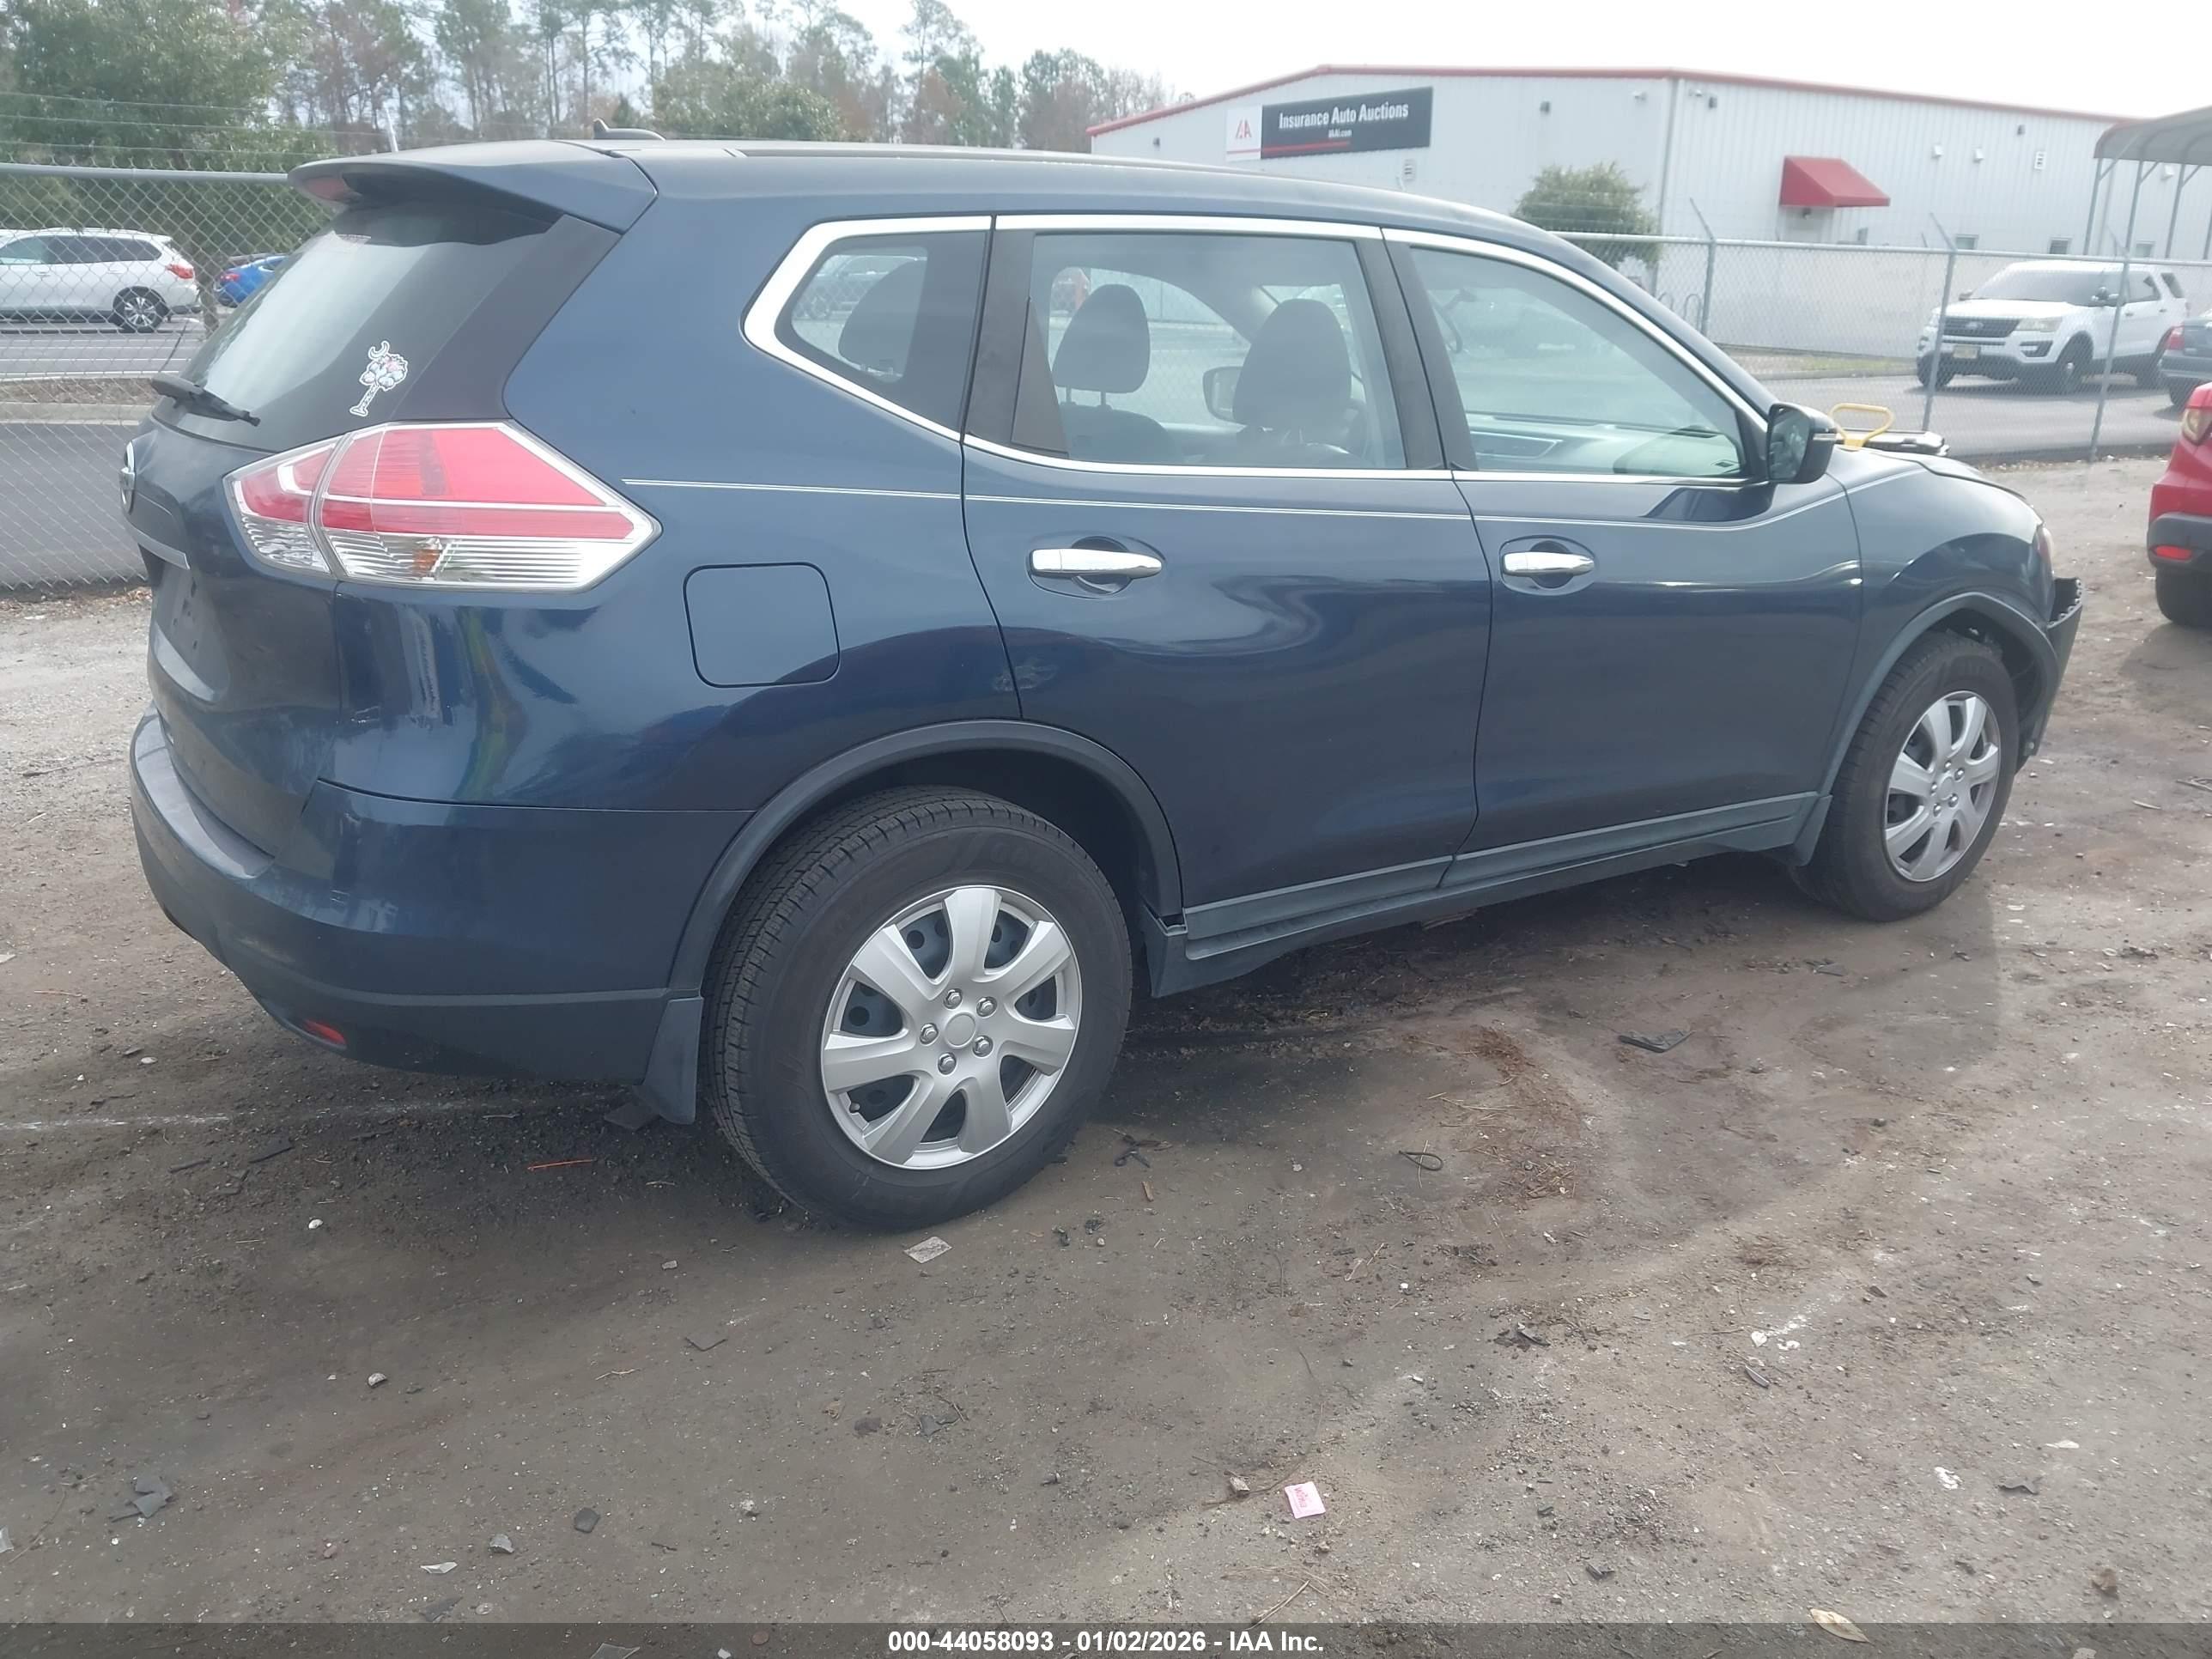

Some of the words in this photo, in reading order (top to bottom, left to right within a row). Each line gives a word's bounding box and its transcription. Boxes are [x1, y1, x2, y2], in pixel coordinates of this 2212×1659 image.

[1279, 112, 1329, 129] Insurance
[1331, 106, 1357, 125] Auto
[1358, 101, 1409, 122] Auctions
